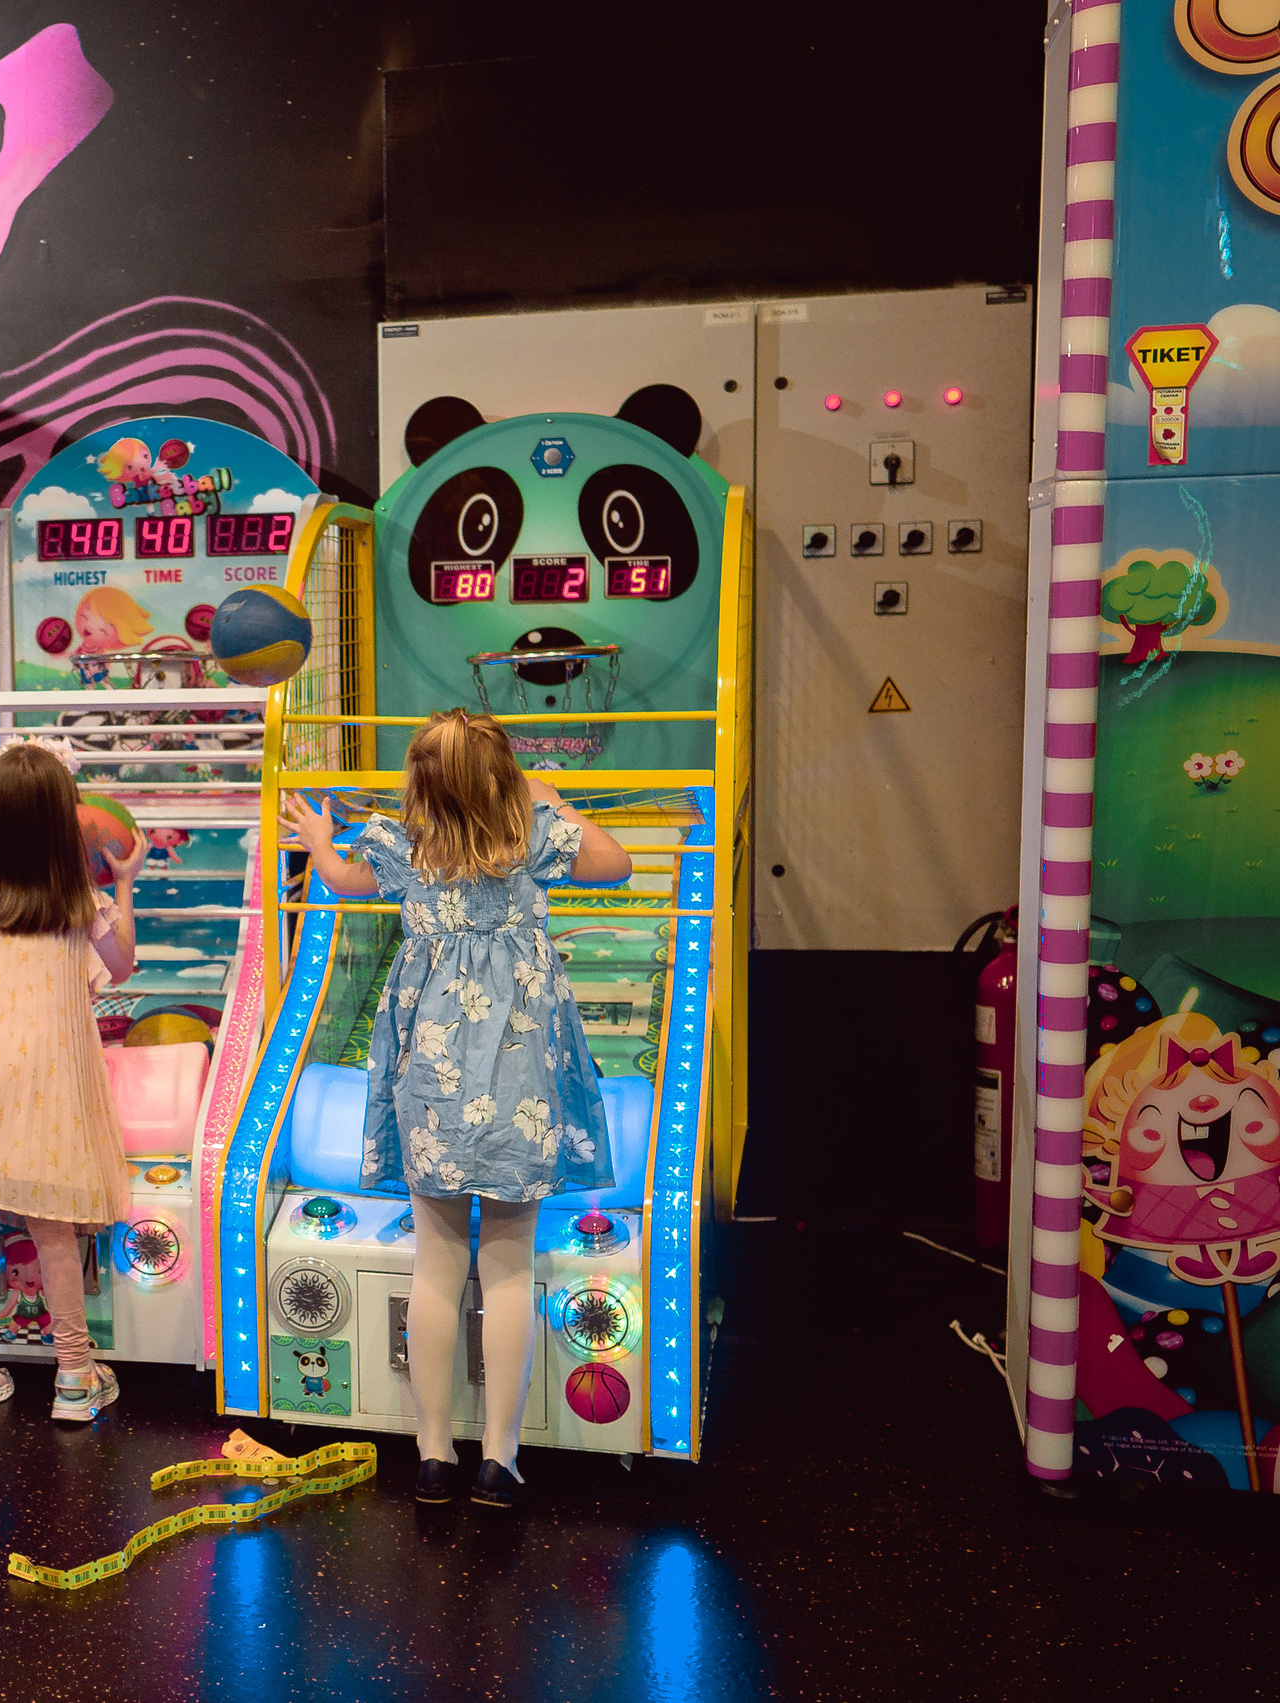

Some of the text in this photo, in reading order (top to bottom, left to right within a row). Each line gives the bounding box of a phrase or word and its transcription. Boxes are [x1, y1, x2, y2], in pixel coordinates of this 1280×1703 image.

[1138, 346, 1205, 364] TIKET
[71, 520, 119, 556] 40
[142, 518, 191, 554] 40
[268, 515, 292, 551] 2
[224, 566, 278, 582] SCORE
[531, 558, 567, 566] SCORE
[53, 570, 107, 586] HIGHEST
[144, 569, 183, 584] TIME
[456, 573, 492, 598] 80
[562, 567, 585, 599] 2
[630, 567, 667, 594] 51
